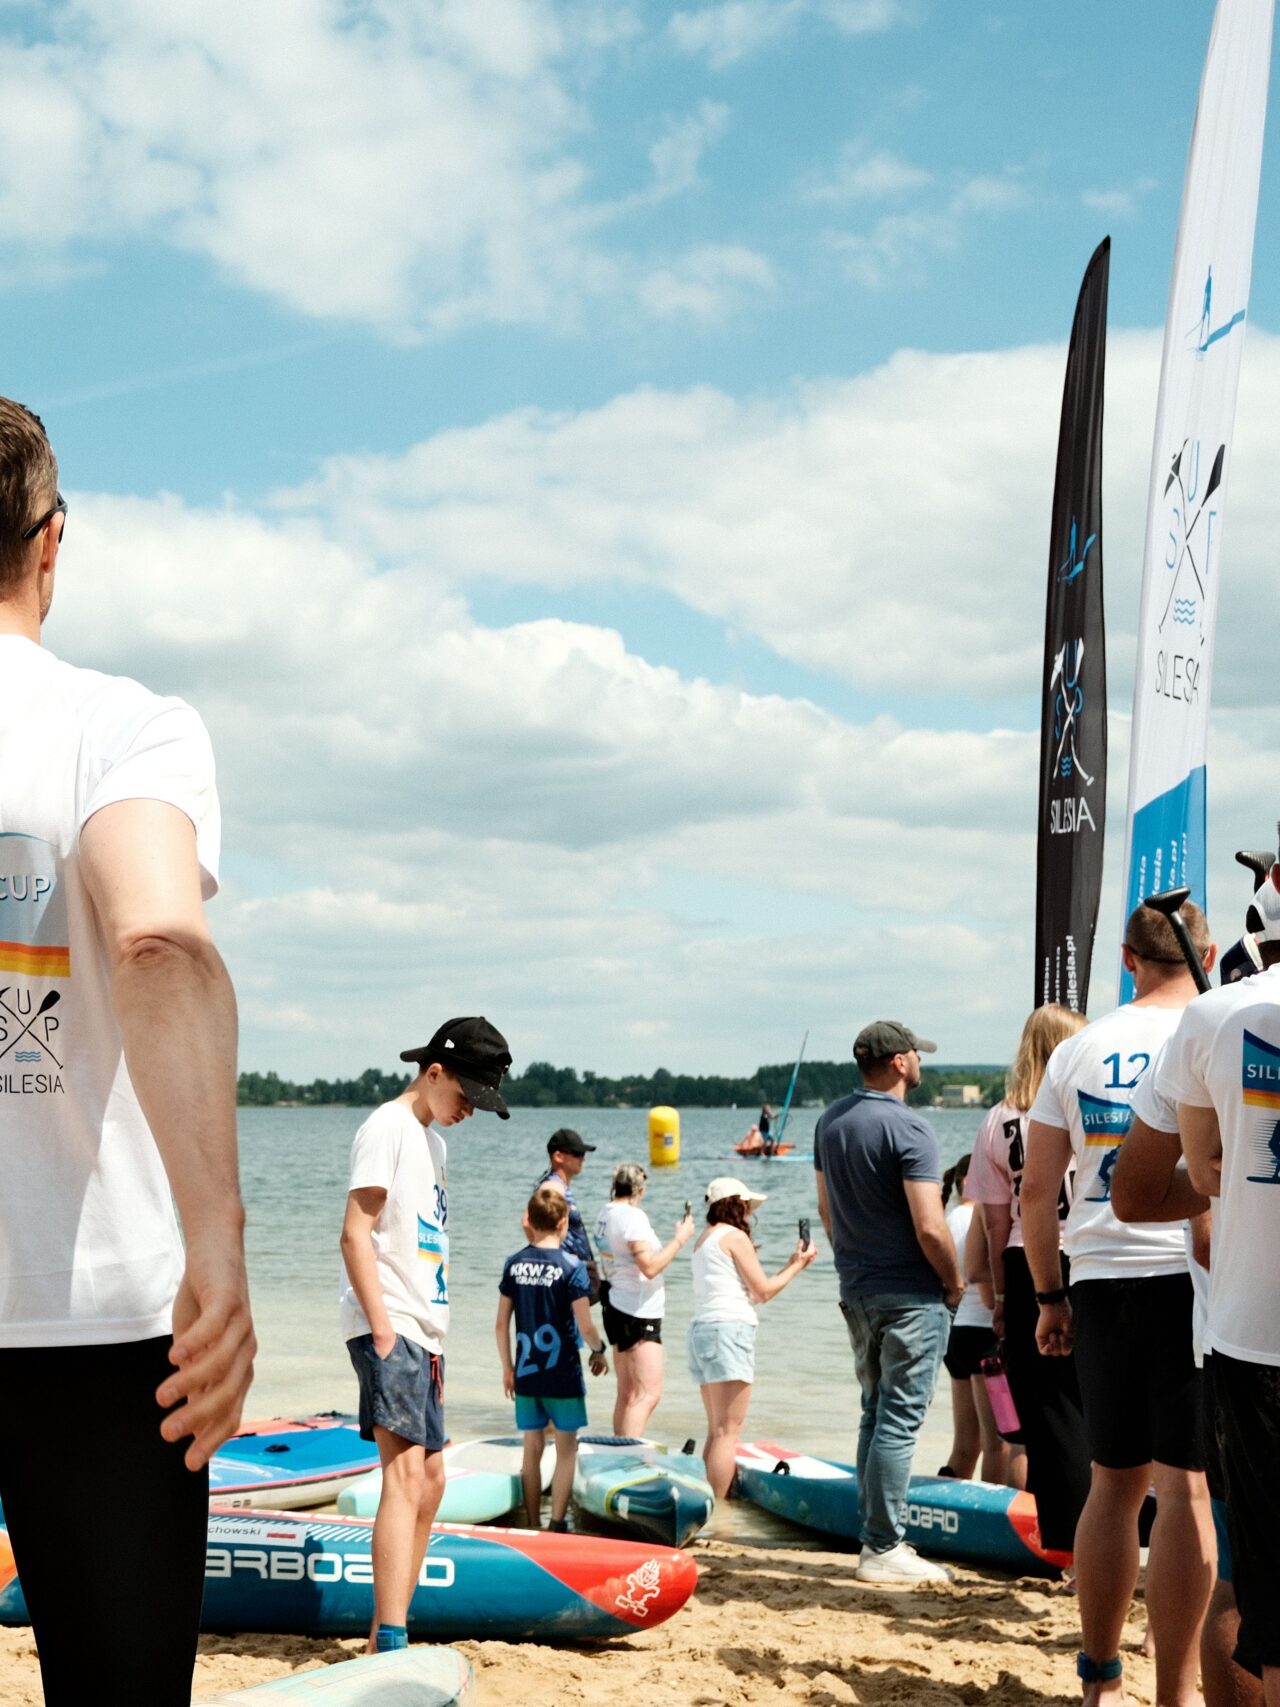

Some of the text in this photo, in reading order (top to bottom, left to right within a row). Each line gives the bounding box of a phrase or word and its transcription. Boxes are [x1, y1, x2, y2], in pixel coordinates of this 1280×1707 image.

[1051, 797, 1096, 834] SILESIA
[1102, 1052, 1150, 1089] 12
[1247, 1063, 1280, 1080] SIL
[433, 1184, 447, 1227] 39
[510, 1262, 564, 1281] KKW 29
[516, 1323, 561, 1378] 29
